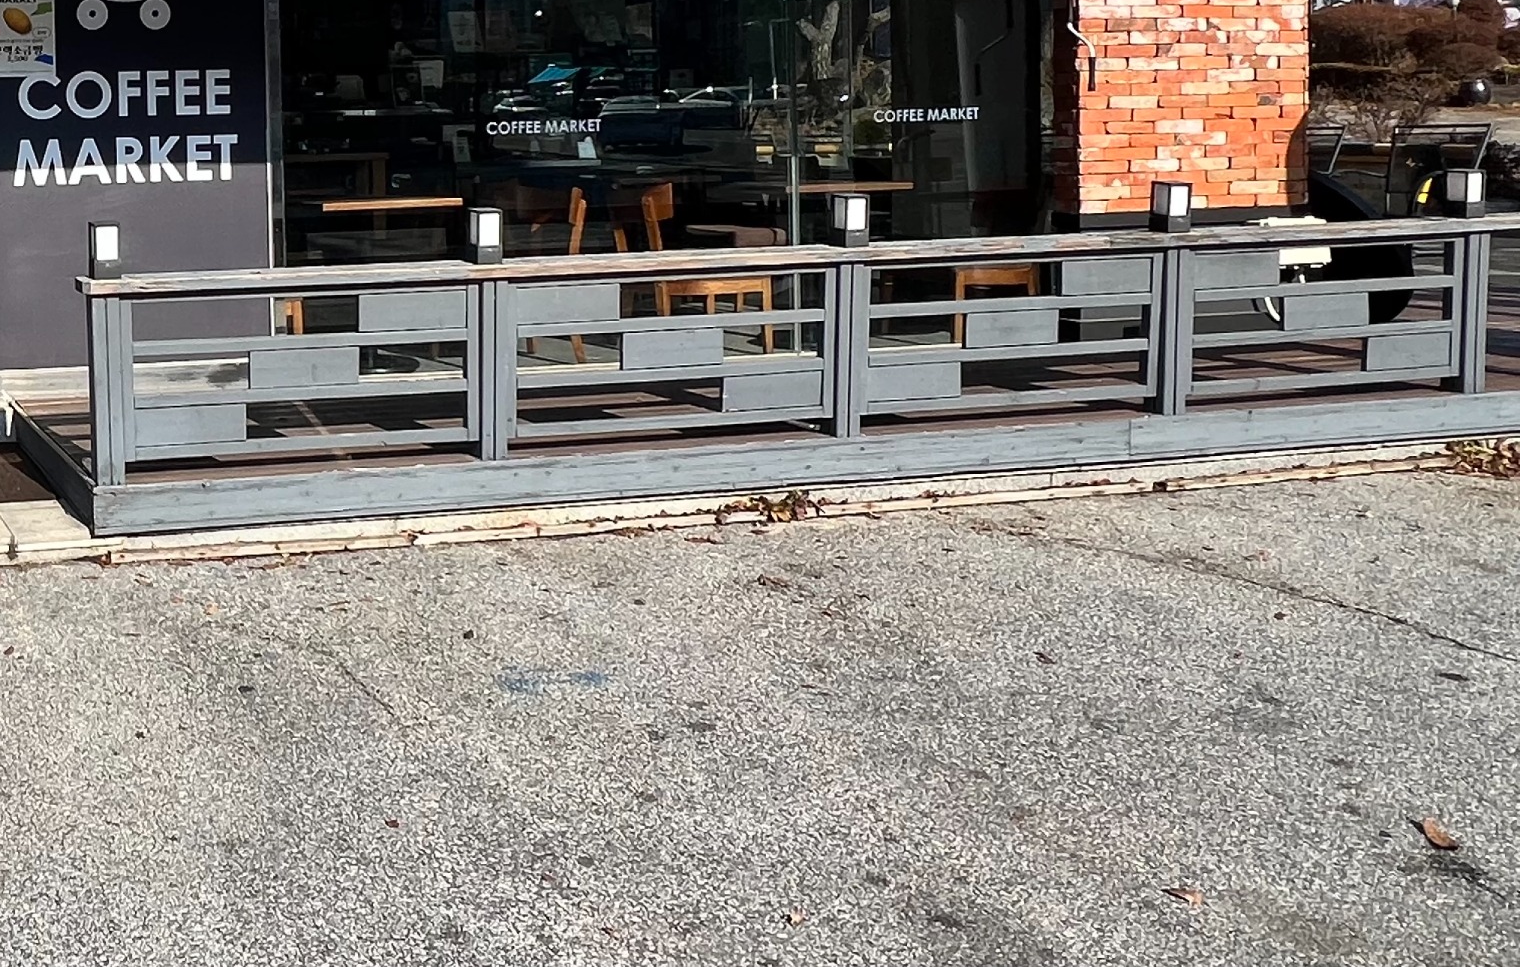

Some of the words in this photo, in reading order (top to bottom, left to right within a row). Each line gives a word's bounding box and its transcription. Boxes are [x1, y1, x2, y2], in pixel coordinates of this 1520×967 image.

[18, 69, 231, 120] COFFEE
[486, 120, 541, 135] COFFEE
[544, 119, 601, 134] MARKET
[873, 108, 925, 123] COFFEE
[927, 107, 979, 122] MARKET
[13, 134, 238, 186] MARKET
